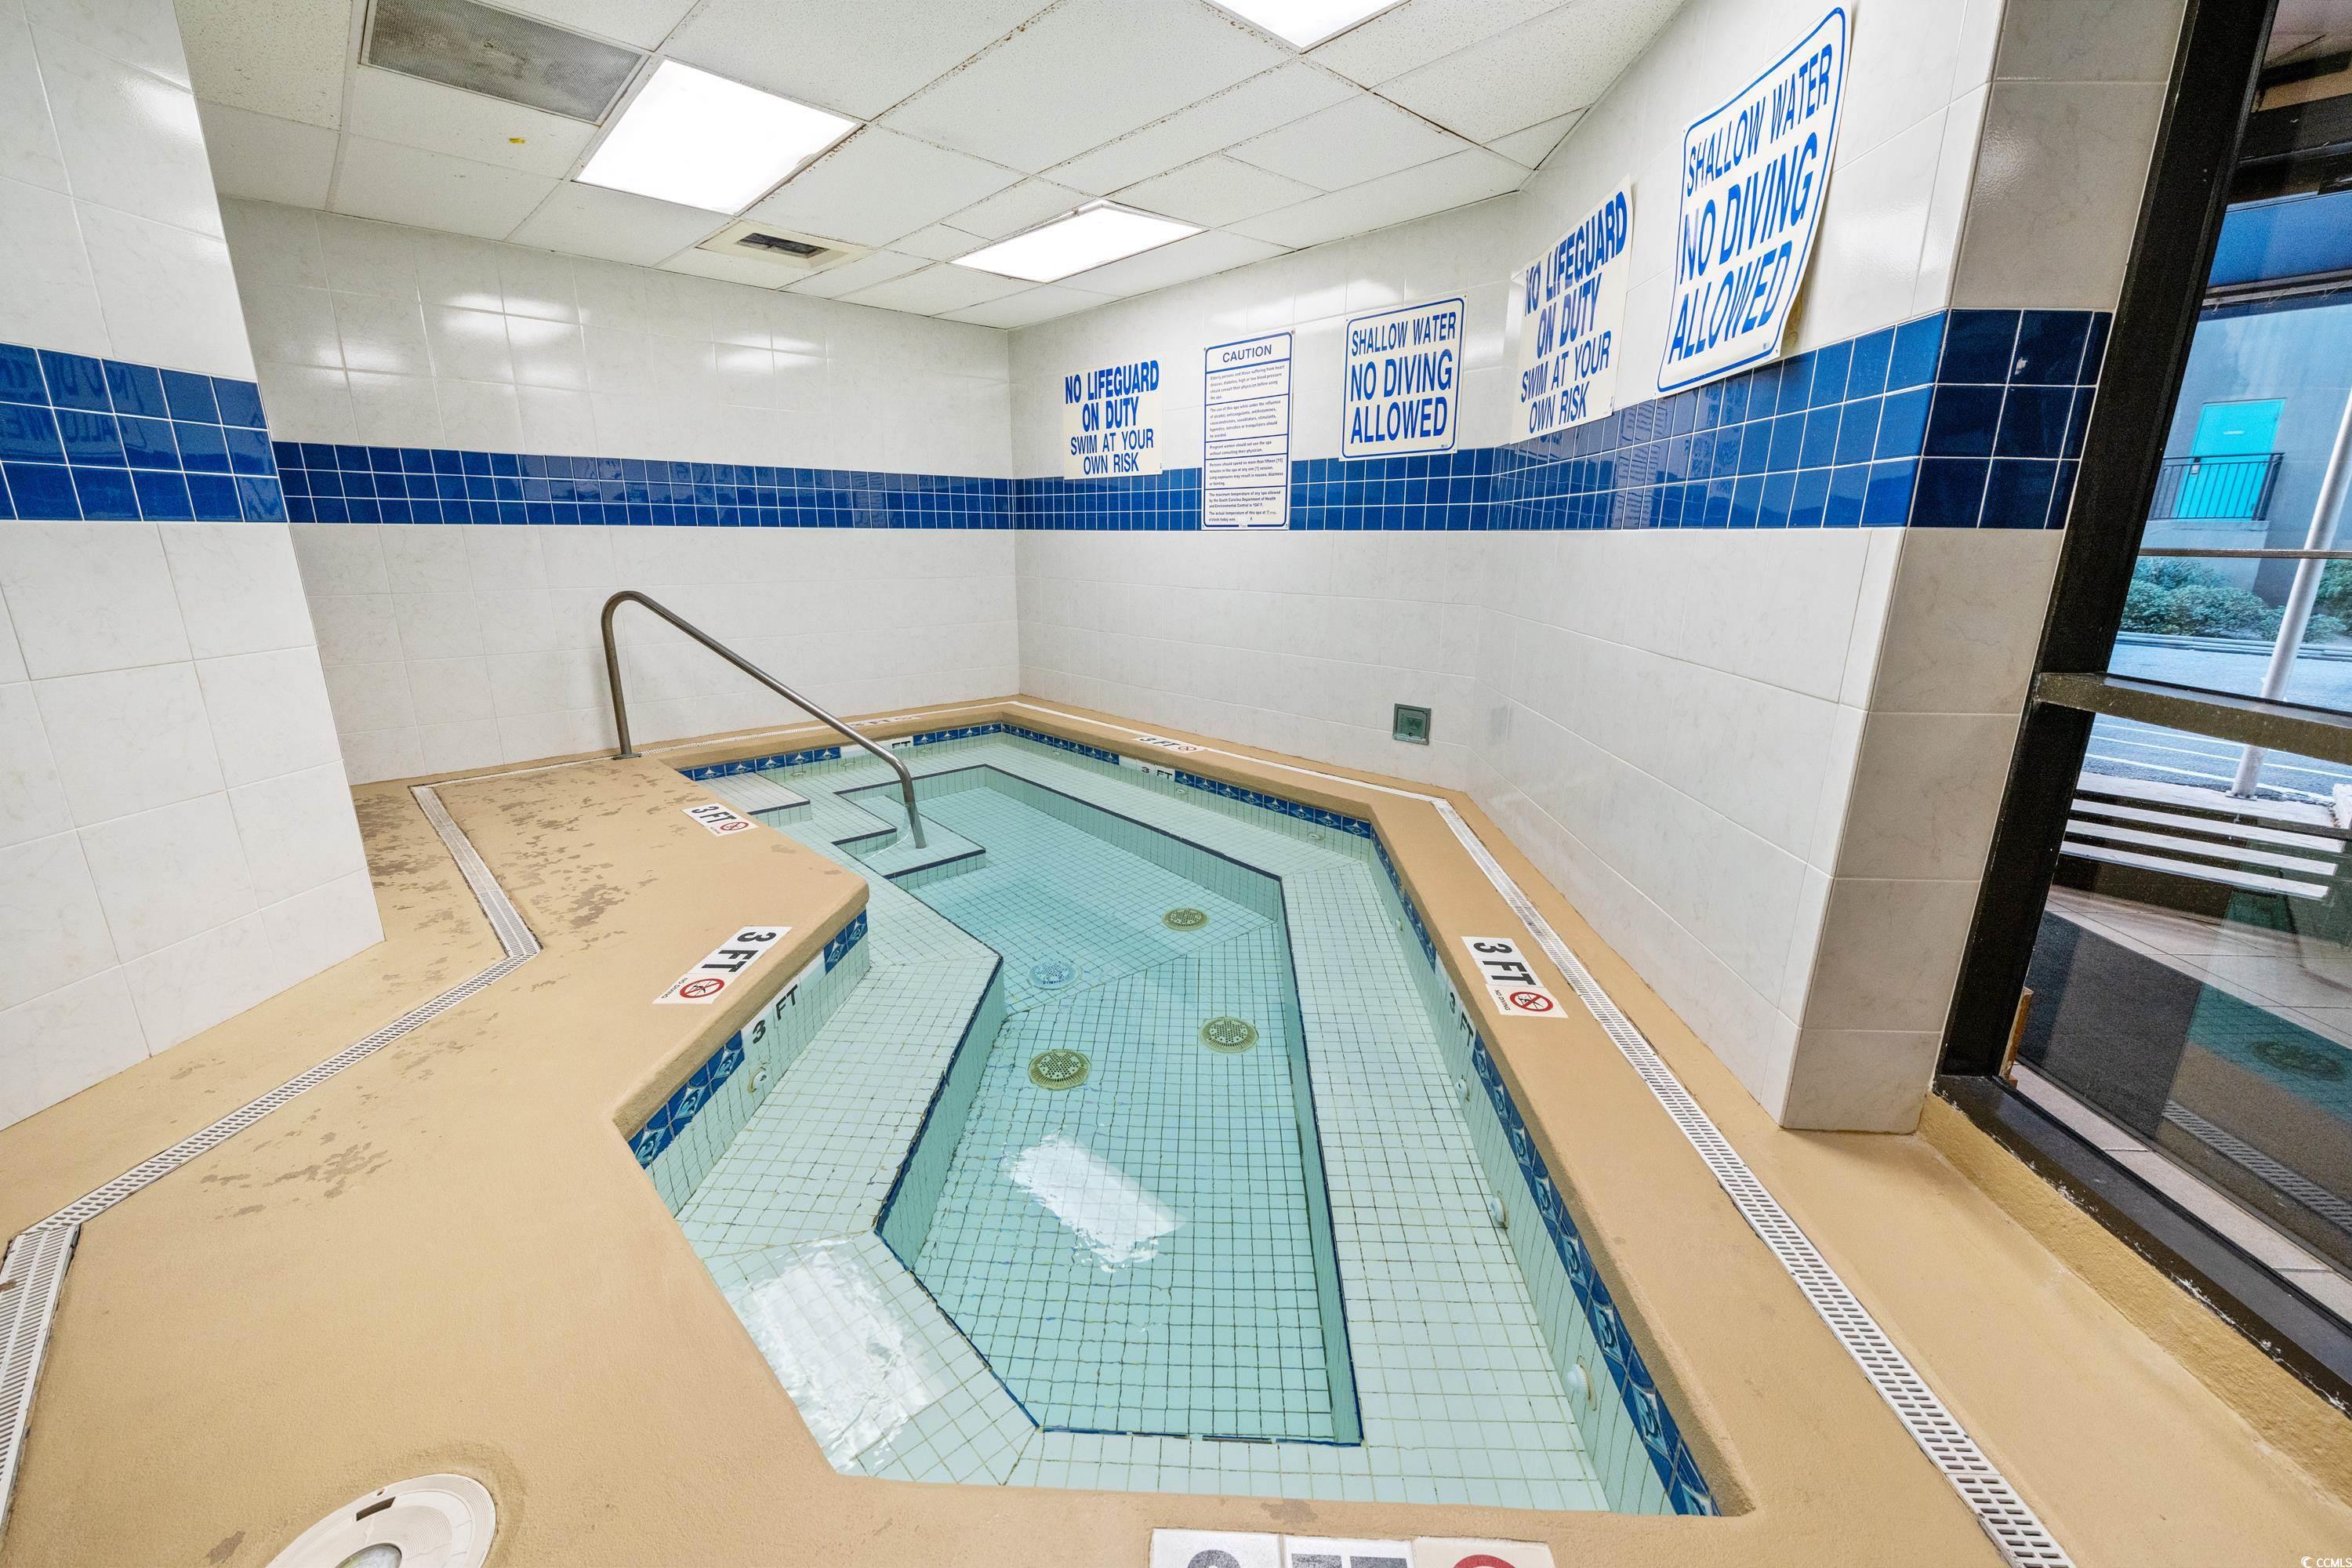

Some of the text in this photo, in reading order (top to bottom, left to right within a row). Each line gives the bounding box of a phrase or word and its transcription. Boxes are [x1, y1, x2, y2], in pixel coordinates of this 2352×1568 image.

[1687, 43, 1832, 198] SHALLOW WATER
[1680, 132, 1818, 286] NO DIVING
[1525, 191, 1627, 317] NO LIFEGUARD
[1537, 272, 1602, 359] ON DUTY
[1668, 240, 1792, 365] ALLOWED
[1223, 345, 1272, 363] CAUTION
[1352, 312, 1456, 356] SHALLOW WATER
[1065, 360, 1159, 404] NO LIFEGUARD
[1351, 349, 1452, 401] NO DIVING
[1521, 330, 1611, 403] SWIM AT YOUR
[1082, 396, 1138, 432] ON DUTY
[1351, 396, 1447, 444] ALLOWED
[1529, 381, 1590, 434] OWN RISK
[1071, 428, 1154, 456] SWIM AT YOUR
[1083, 453, 1139, 474] OWN RISK
[1157, 770, 1172, 779] FT
[699, 811, 737, 823] FT
[701, 931, 776, 973] 3 FT
[1473, 942, 1536, 985] 3 FT
[753, 984, 798, 1044] 3 FT
[1494, 989, 1510, 1011] NO DIVING
[1460, 1011, 1474, 1047] FT
